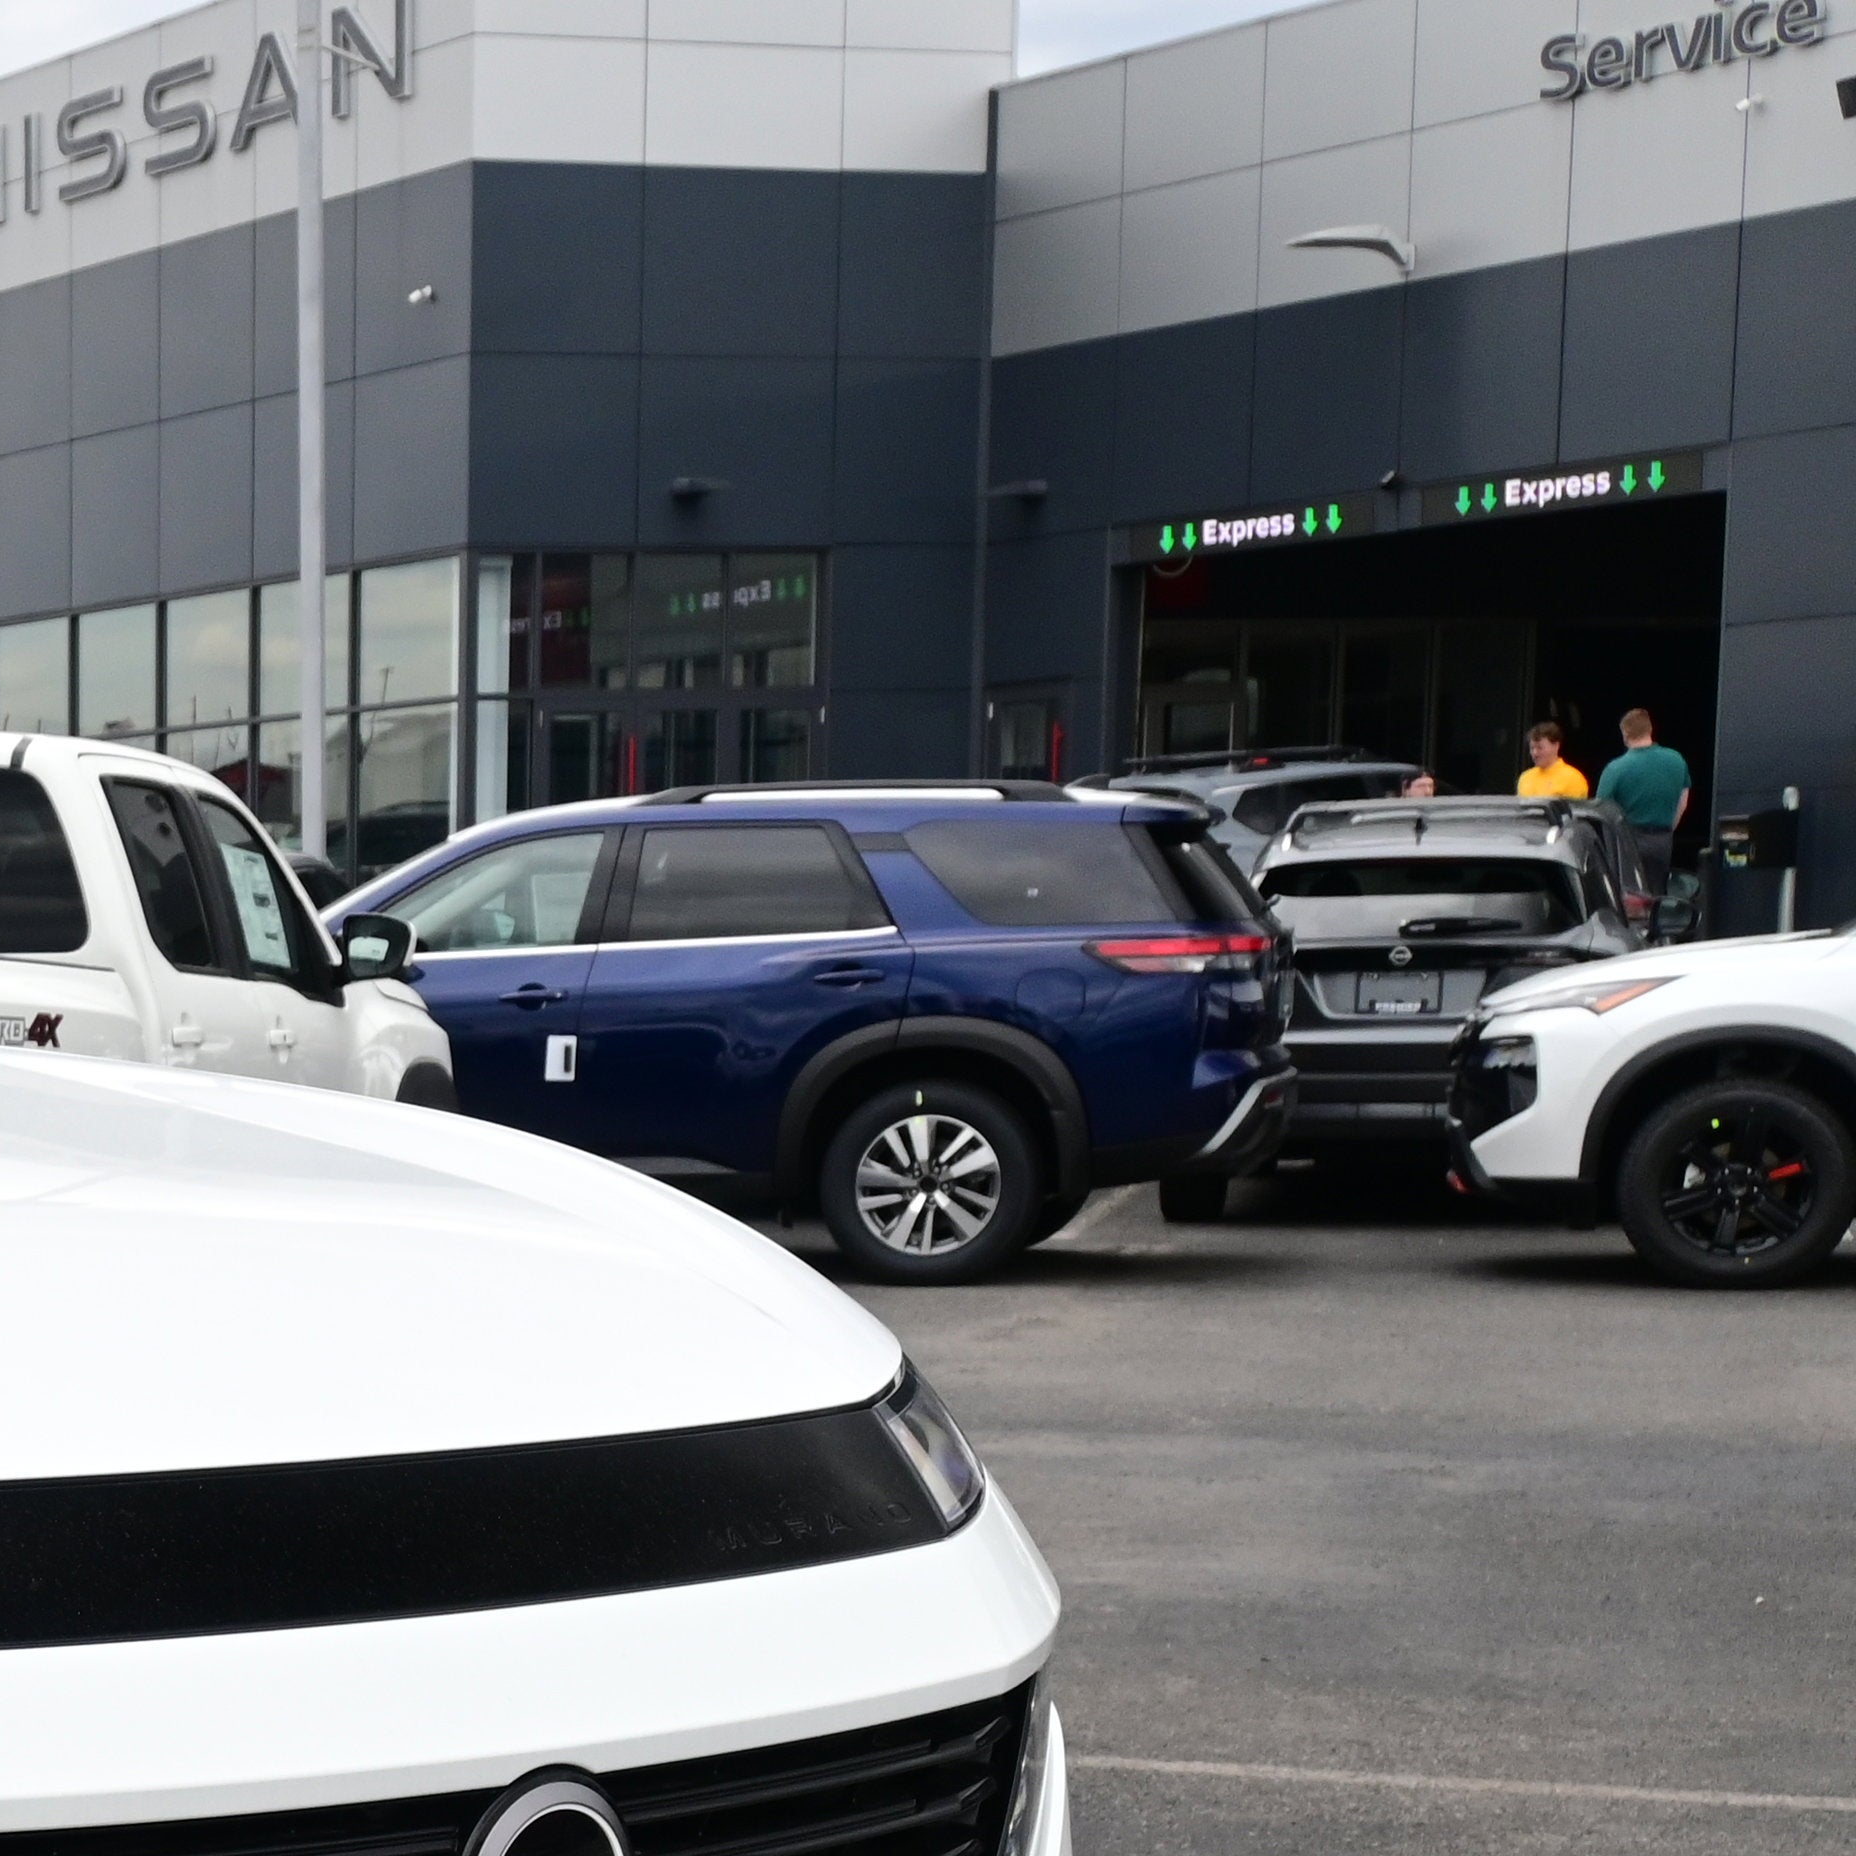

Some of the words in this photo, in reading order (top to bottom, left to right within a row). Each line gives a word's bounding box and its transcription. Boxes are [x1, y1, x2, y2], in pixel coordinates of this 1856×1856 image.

[1540, 0, 1826, 100] Service
[1505, 471, 1611, 508] Express
[1202, 513, 1295, 547] Express
